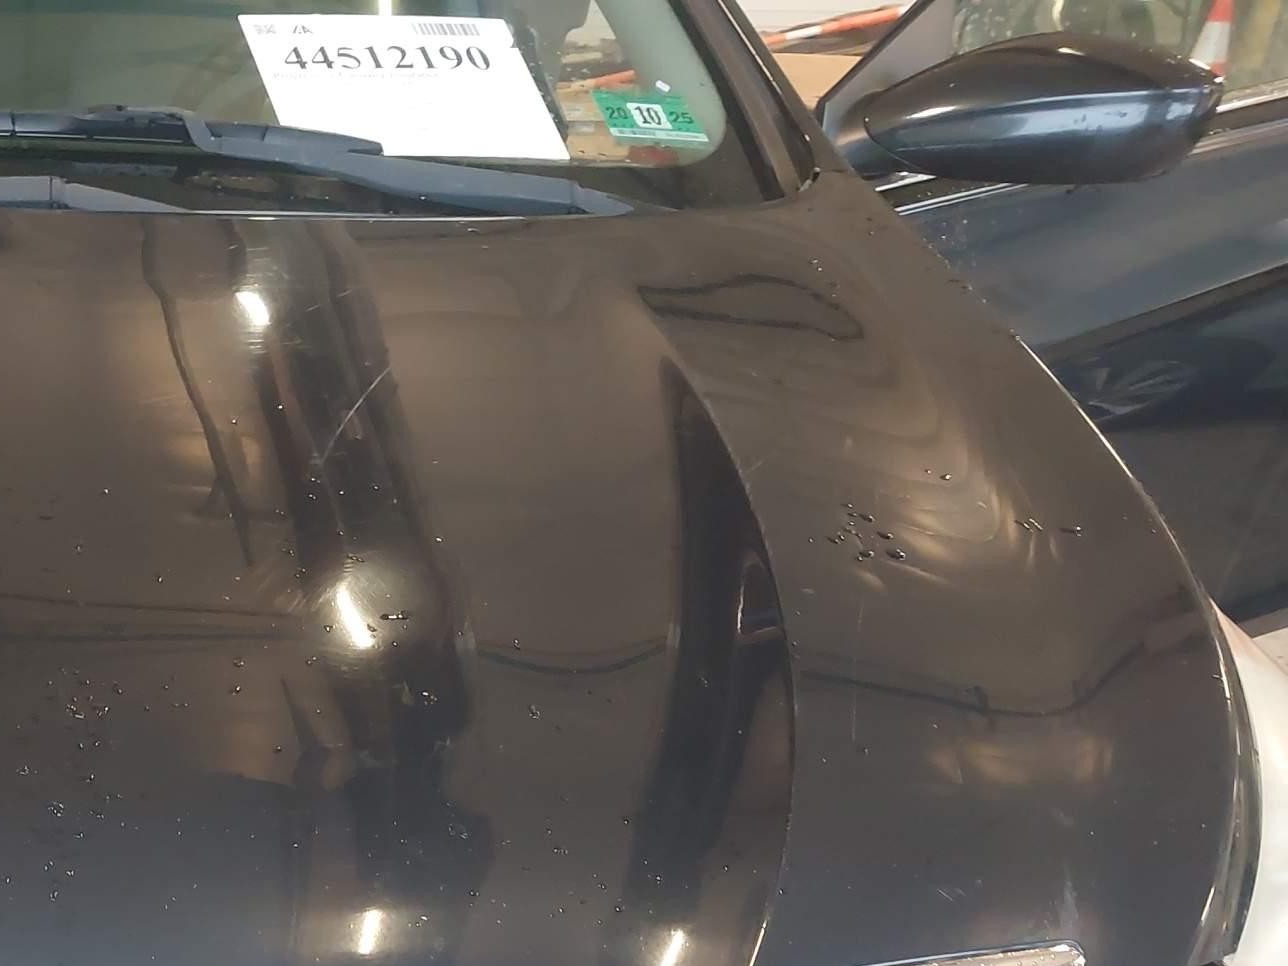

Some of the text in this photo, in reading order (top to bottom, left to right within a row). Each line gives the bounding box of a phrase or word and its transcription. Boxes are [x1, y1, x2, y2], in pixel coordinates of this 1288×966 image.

[284, 45, 490, 70] 44512190
[606, 106, 694, 126] 20 10 25
